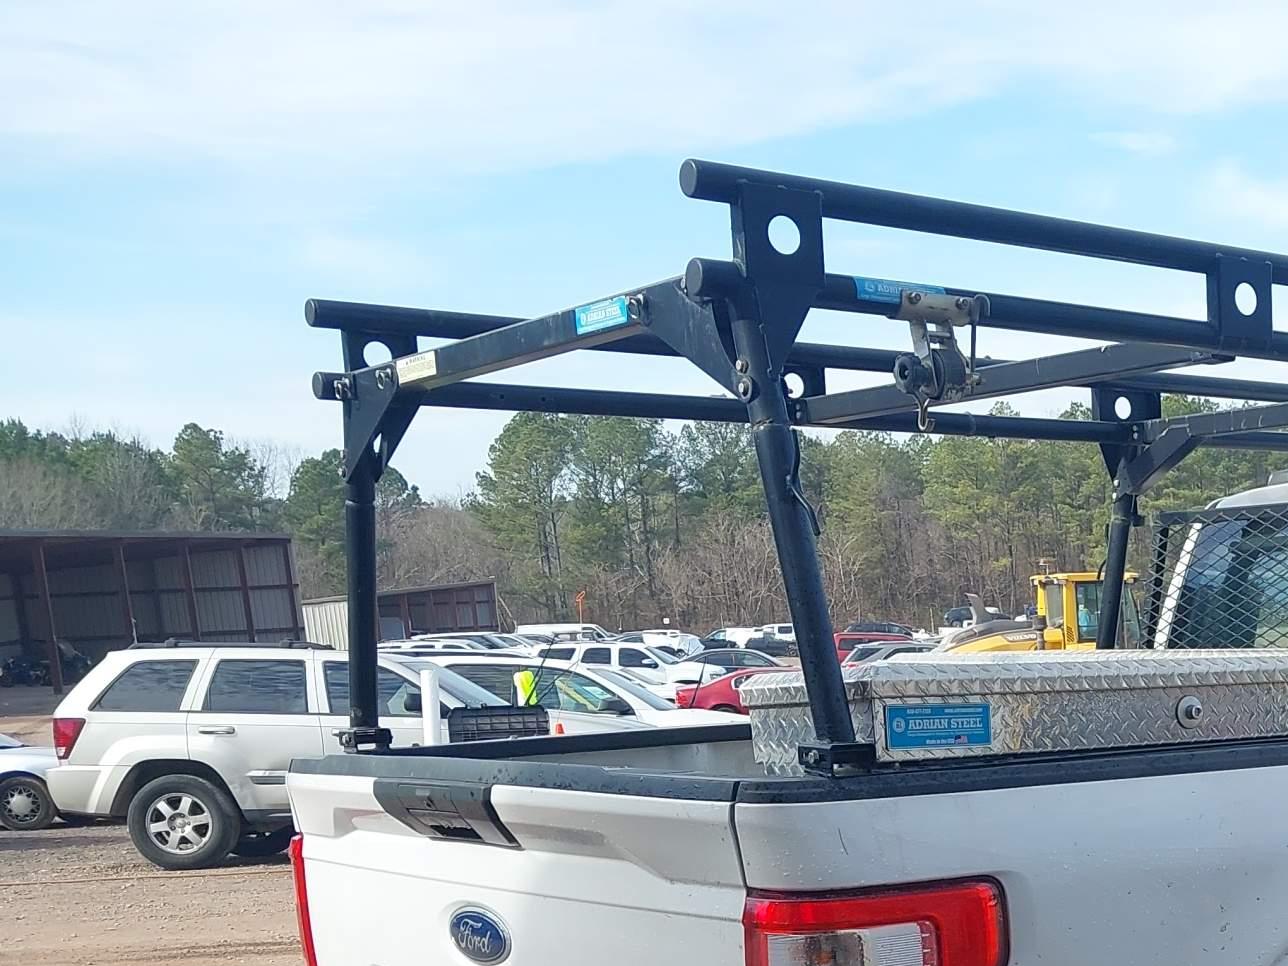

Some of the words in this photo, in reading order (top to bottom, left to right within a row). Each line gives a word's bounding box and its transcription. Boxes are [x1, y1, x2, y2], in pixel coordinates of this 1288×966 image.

[908, 718, 948, 730] ADRIAN
[950, 717, 983, 729] STEEL
[458, 918, 492, 954] Ford
